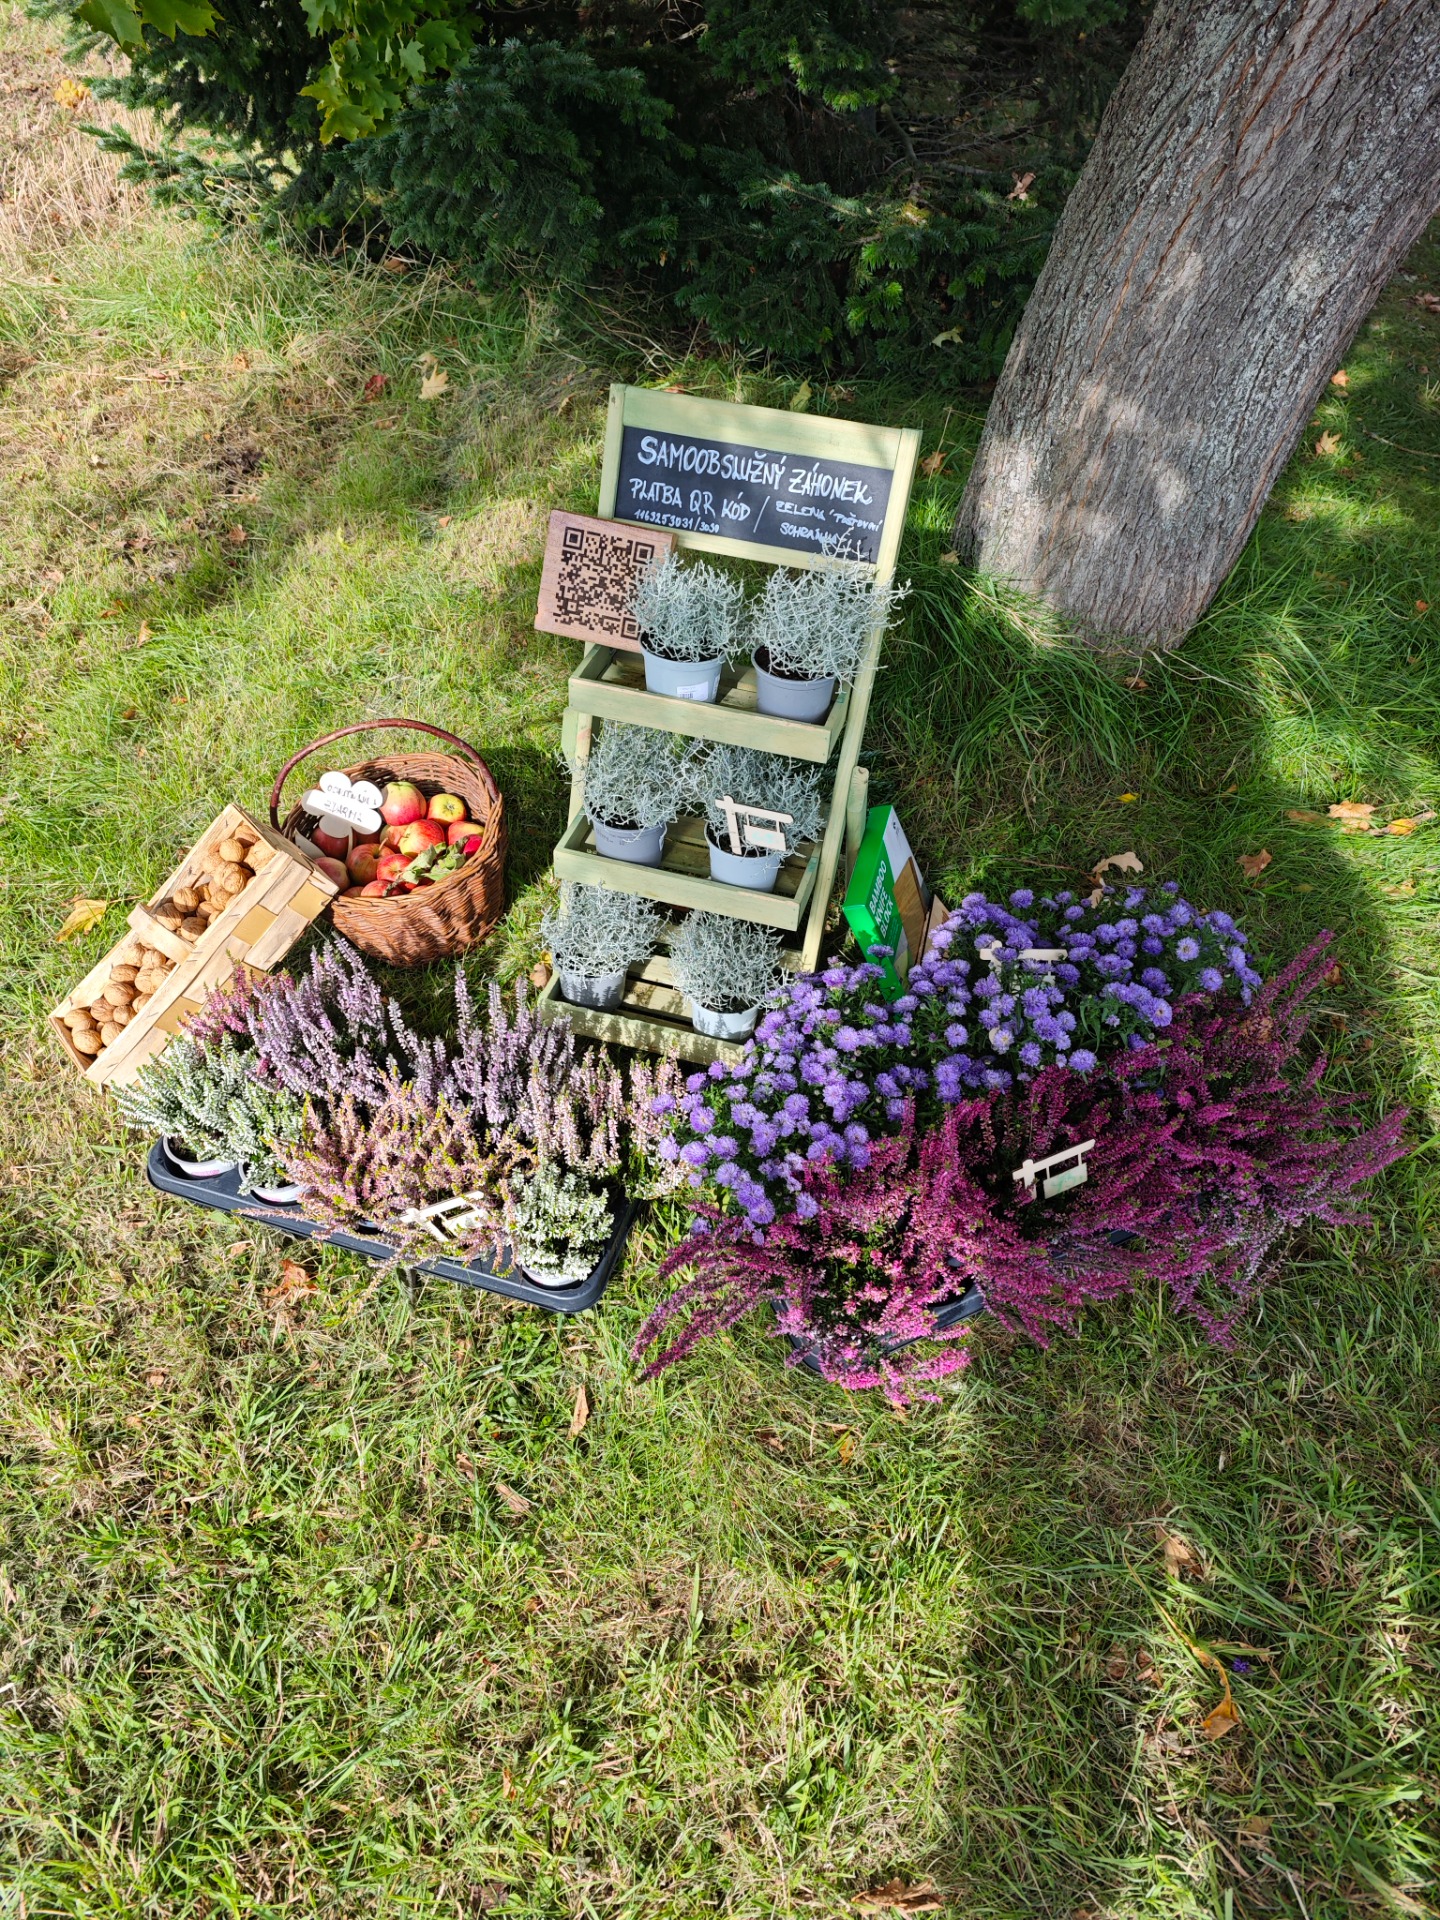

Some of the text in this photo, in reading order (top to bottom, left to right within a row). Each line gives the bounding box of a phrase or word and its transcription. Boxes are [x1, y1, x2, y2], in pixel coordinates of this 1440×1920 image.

[638, 435, 873, 505] SAMOOBSLUŽNÝ ZÁHONEK
[629, 478, 682, 509] PLATBA
[689, 489, 716, 519] QR
[721, 491, 751, 521] KÓD
[869, 860, 887, 915] BAMBOO
[875, 886, 888, 927] KNIFE
[880, 895, 893, 939] BLOCK
